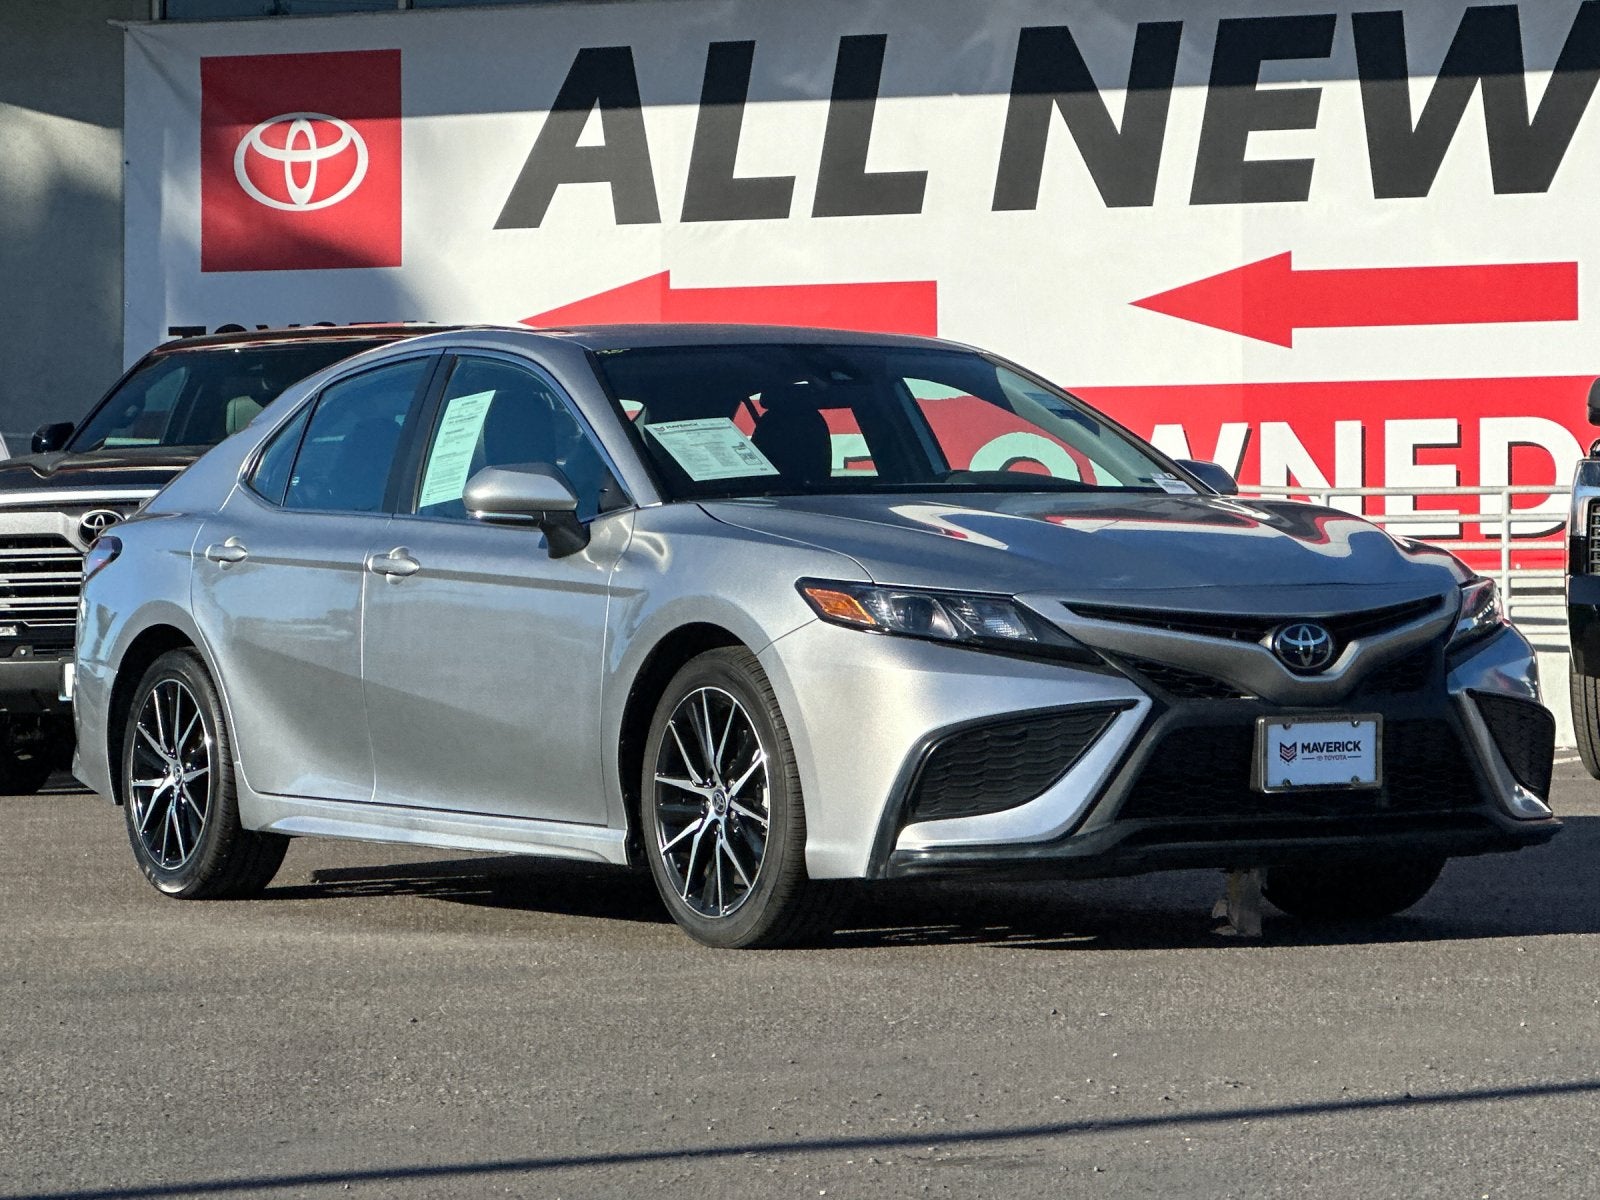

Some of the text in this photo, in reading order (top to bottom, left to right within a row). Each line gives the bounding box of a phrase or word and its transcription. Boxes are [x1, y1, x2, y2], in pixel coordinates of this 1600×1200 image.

[493, 1, 1600, 229] ALL NEW
[1301, 741, 1362, 754] MAVERICK
